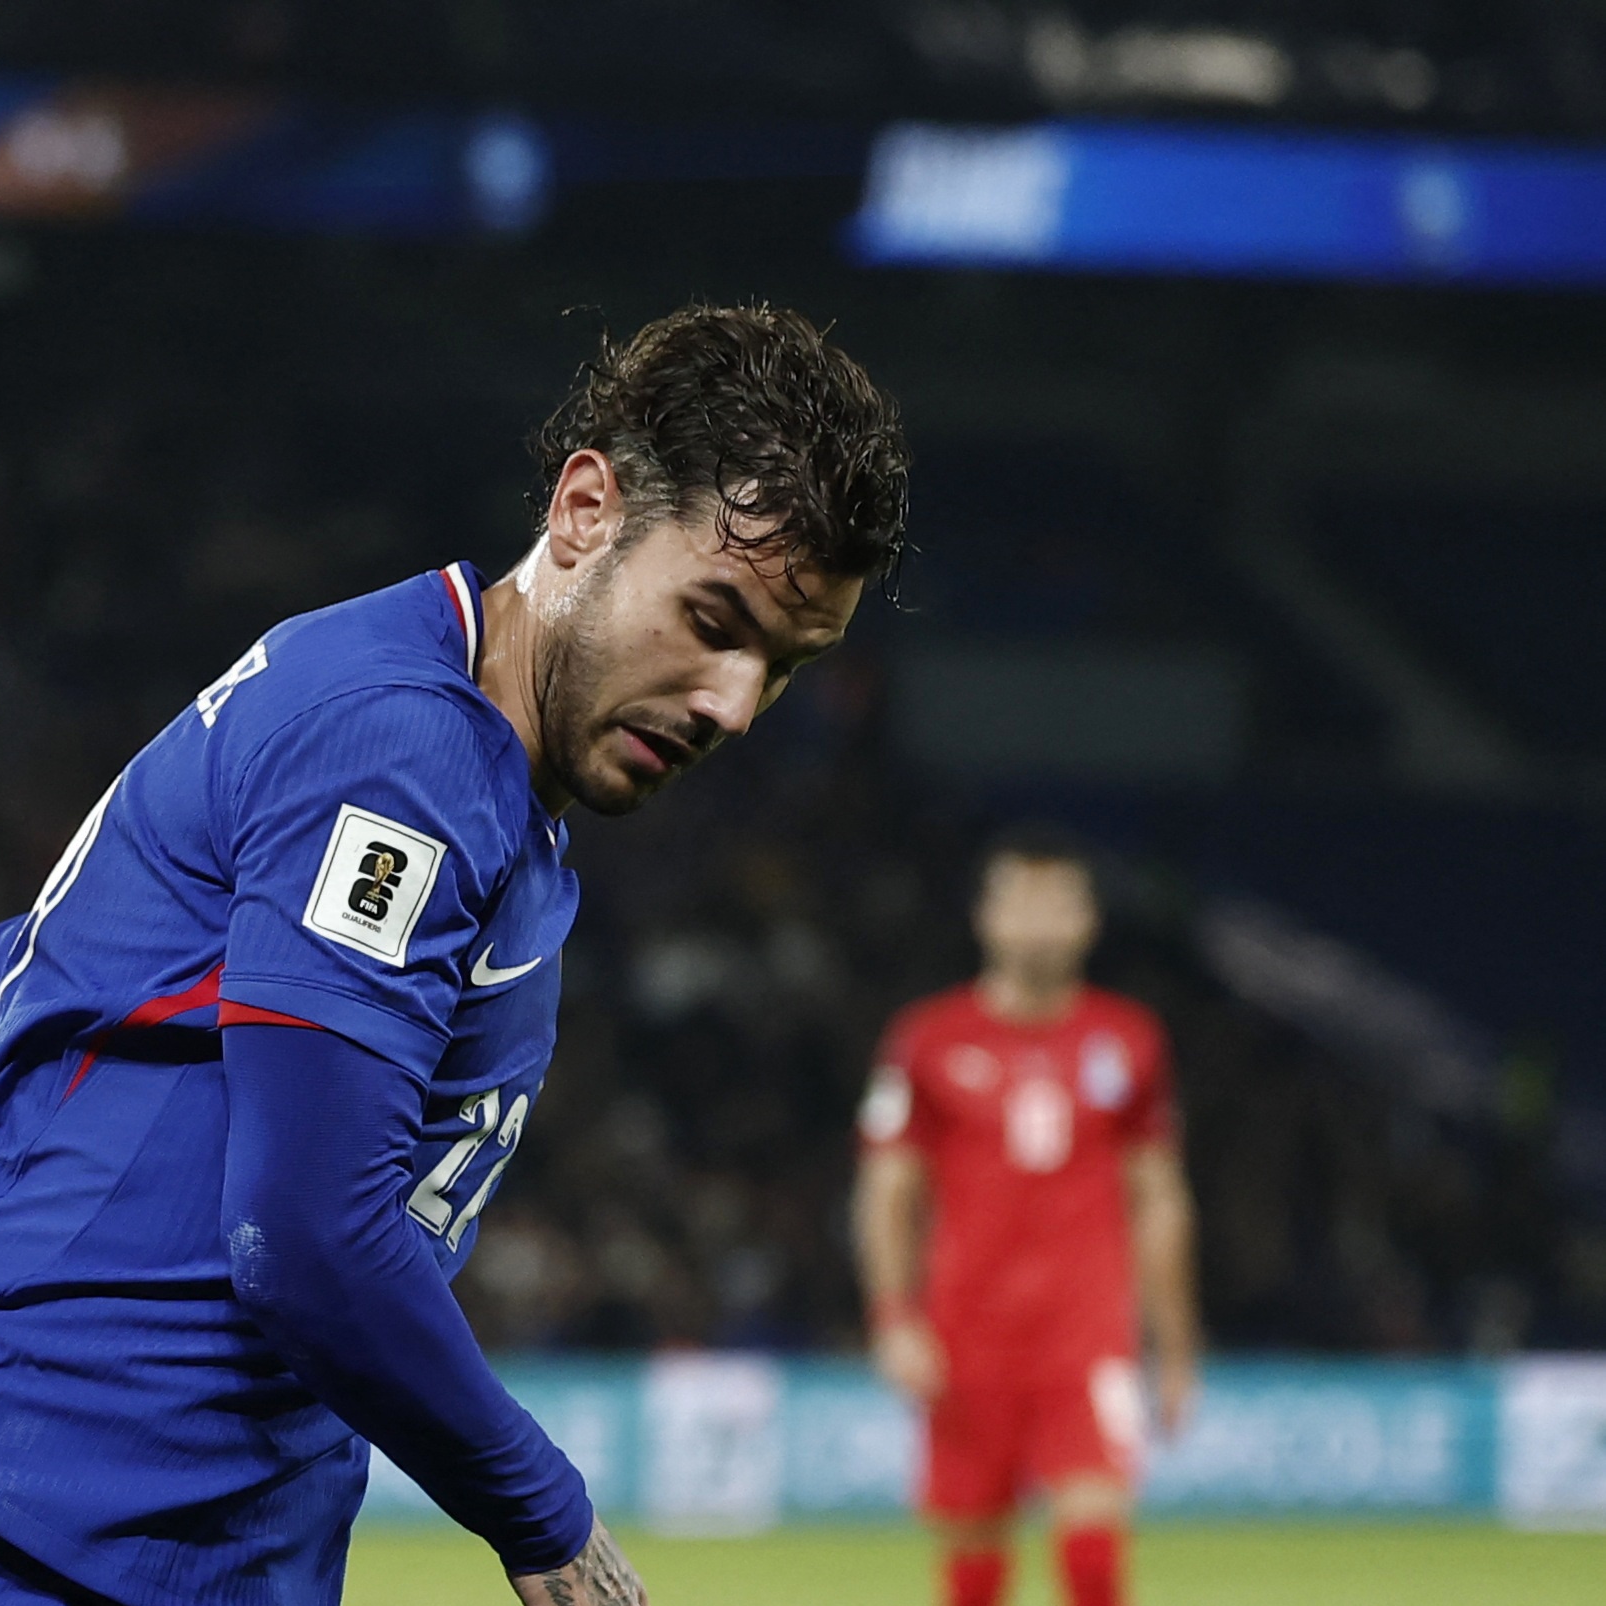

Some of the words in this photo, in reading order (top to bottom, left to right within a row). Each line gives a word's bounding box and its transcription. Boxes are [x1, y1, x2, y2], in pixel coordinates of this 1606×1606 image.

[359, 898, 379, 915] FIFA
[341, 911, 382, 934] QUALIFIERS
[406, 1086, 529, 1254] 22
